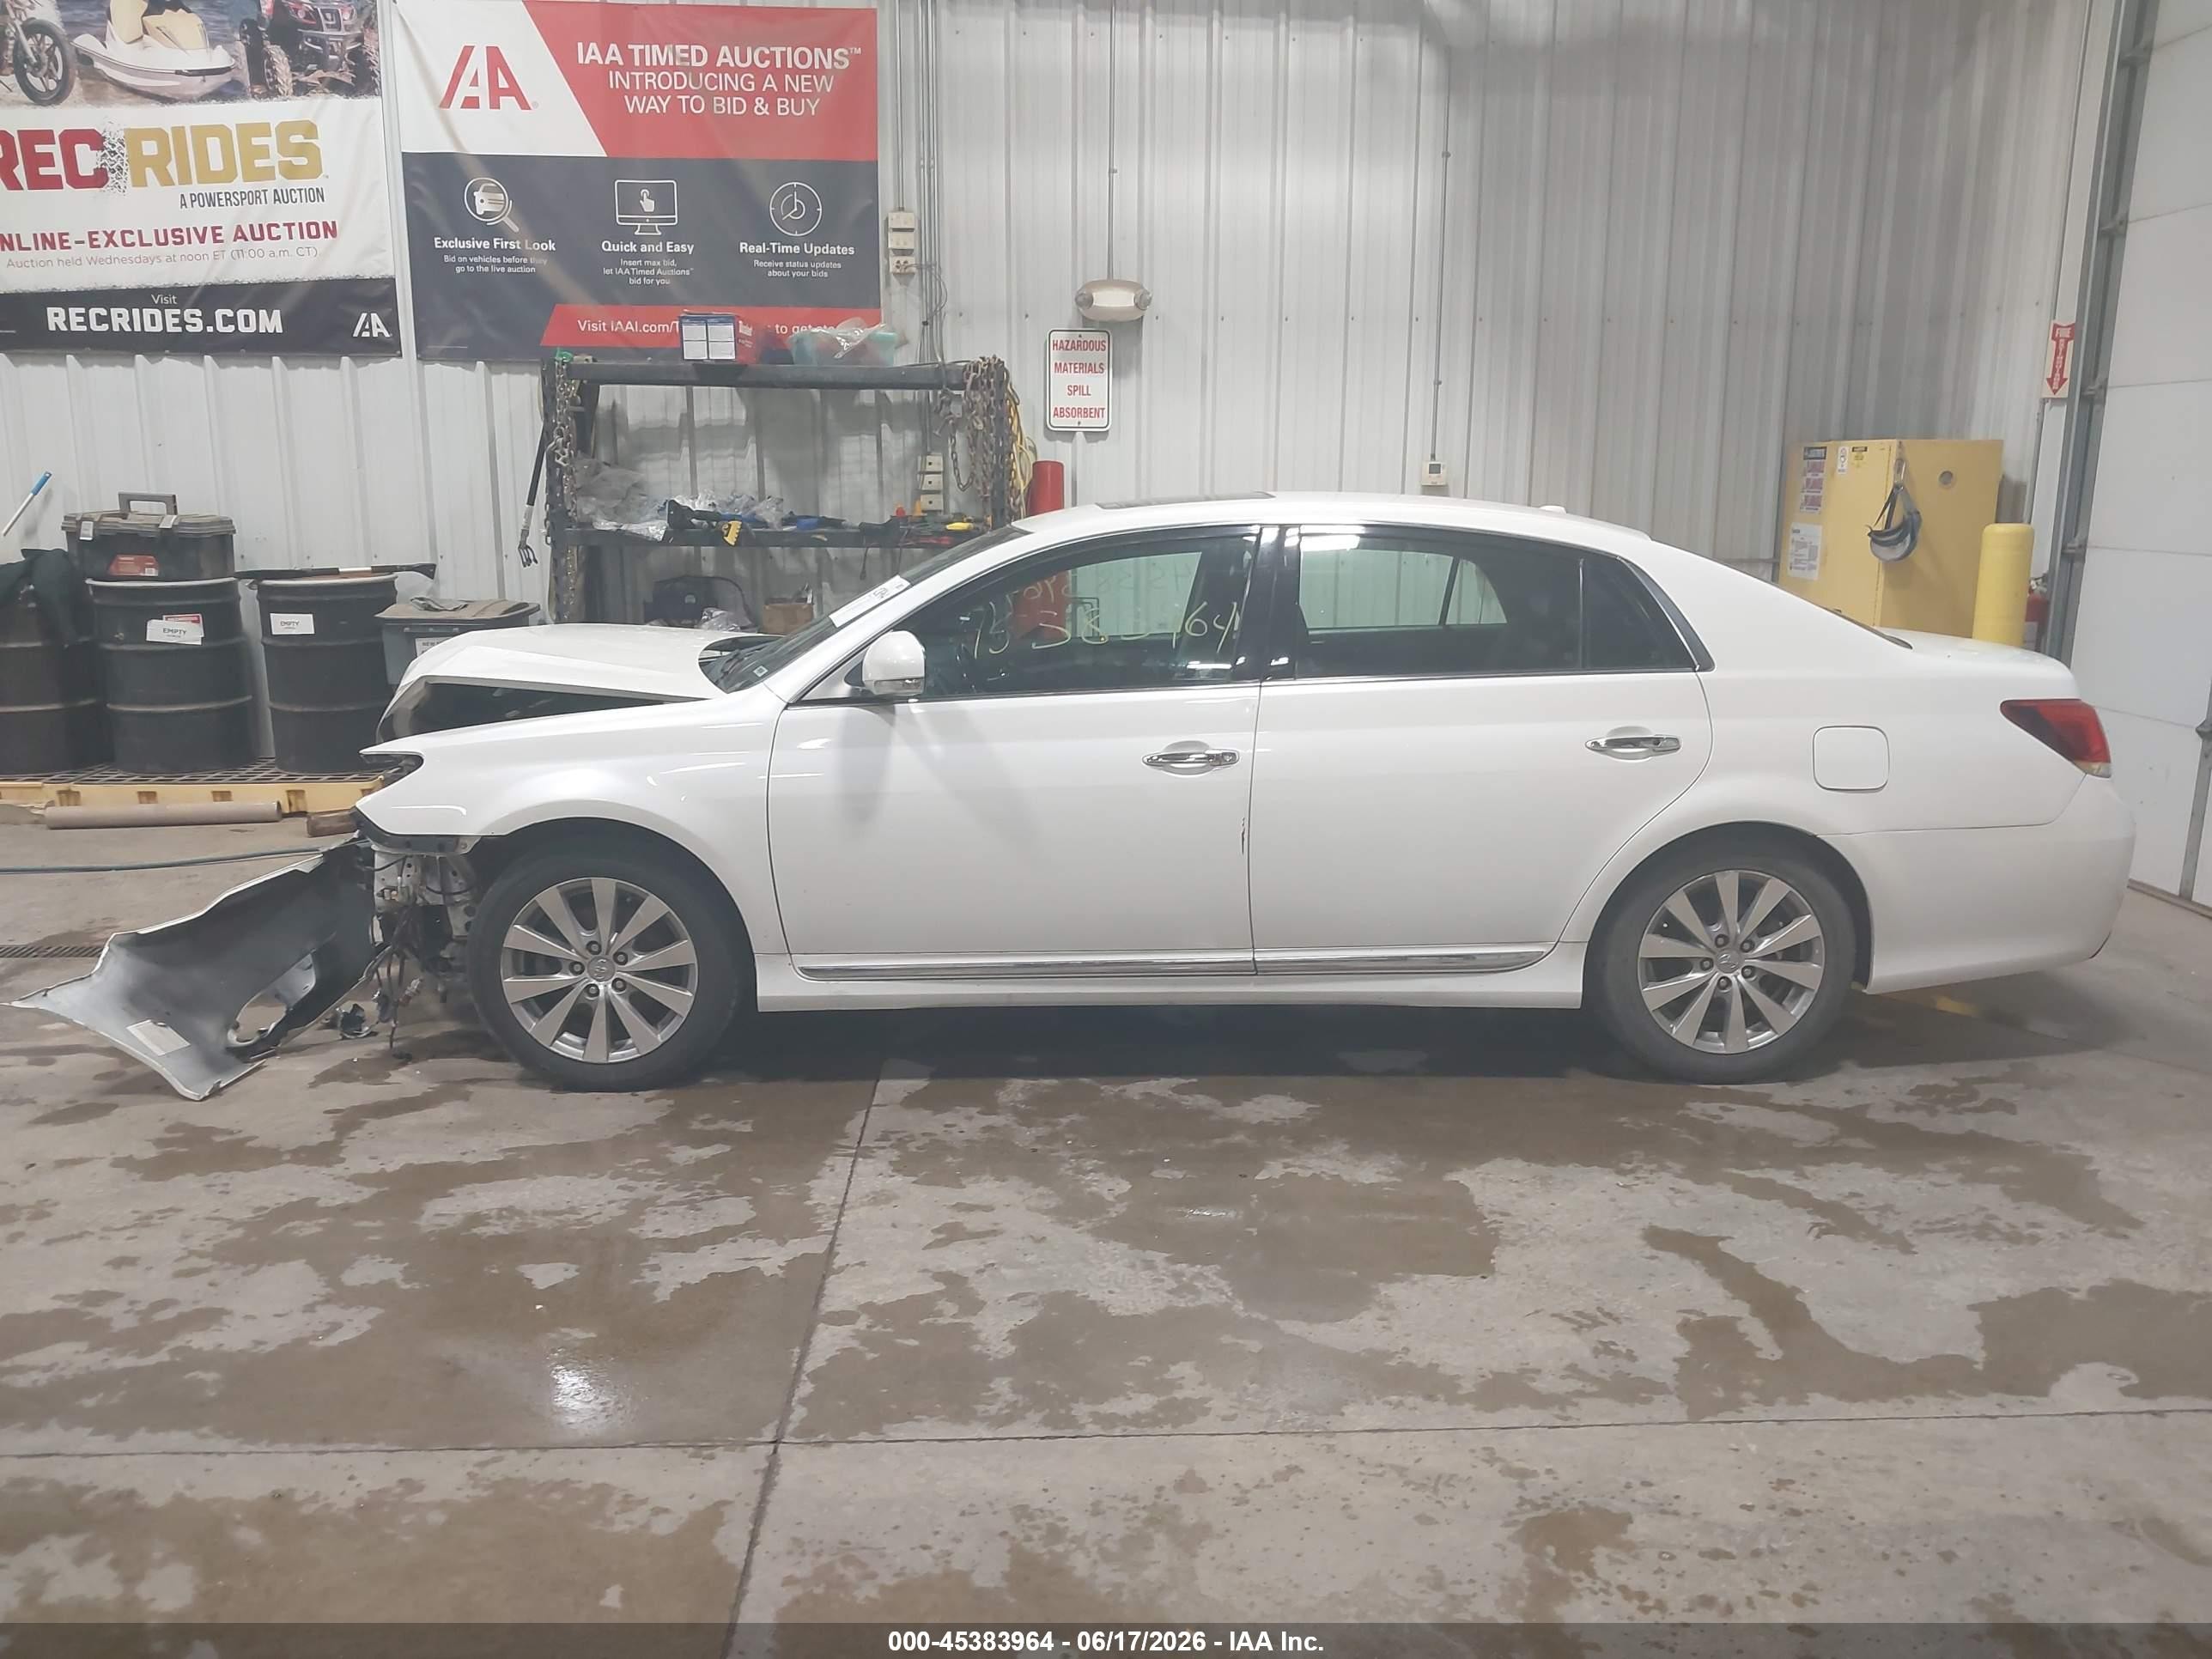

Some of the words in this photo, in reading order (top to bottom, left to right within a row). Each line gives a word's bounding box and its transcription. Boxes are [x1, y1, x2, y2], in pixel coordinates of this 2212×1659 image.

[577, 42, 623, 65] IAA
[628, 43, 708, 68] TIMED
[609, 71, 755, 93] INTRODUCING
[762, 74, 778, 92] A
[784, 74, 835, 94] NEW
[624, 94, 671, 113] WAY
[677, 95, 705, 114] TO
[713, 96, 747, 115] BID
[753, 97, 770, 116] &
[776, 98, 821, 117] BUY
[124, 119, 324, 188] RIDES
[179, 194, 188, 209] A
[189, 189, 269, 209] POWERSPORT
[273, 186, 325, 204] AUCTION
[0, 226, 225, 252] NLINE-EXCLUSIVE
[233, 220, 337, 242] AUCTION
[434, 237, 490, 249] Exclusive
[493, 238, 521, 249] First
[525, 240, 556, 251] Look
[601, 240, 636, 252] Quick
[640, 241, 663, 252] and
[665, 242, 695, 254] Easy
[739, 241, 800, 254] Real-Time
[804, 243, 855, 256] Updates
[6, 257, 53, 269] Auction
[57, 256, 82, 267] held
[86, 252, 161, 266] Wednesdays
[165, 253, 177, 263] at
[179, 252, 210, 262] noon
[212, 249, 226, 260] ET
[443, 254, 456, 263] Bid
[753, 259, 784, 268] Receive
[810, 260, 843, 270] updates
[768, 269, 791, 277] about
[792, 270, 811, 279] your
[811, 269, 829, 277] bids
[151, 294, 178, 304] Visit
[46, 307, 283, 333] RECRIDES.COM
[577, 319, 608, 331] Visit
[611, 321, 680, 334] IAAI.com/T
[775, 324, 789, 334] to
[1052, 339, 1107, 351] HAZARDOUS
[1054, 362, 1105, 374] MATERIALS
[1066, 384, 1092, 396] SPILL
[1053, 407, 1106, 419] ABSORBENT
[162, 627, 187, 636] EMPTY
